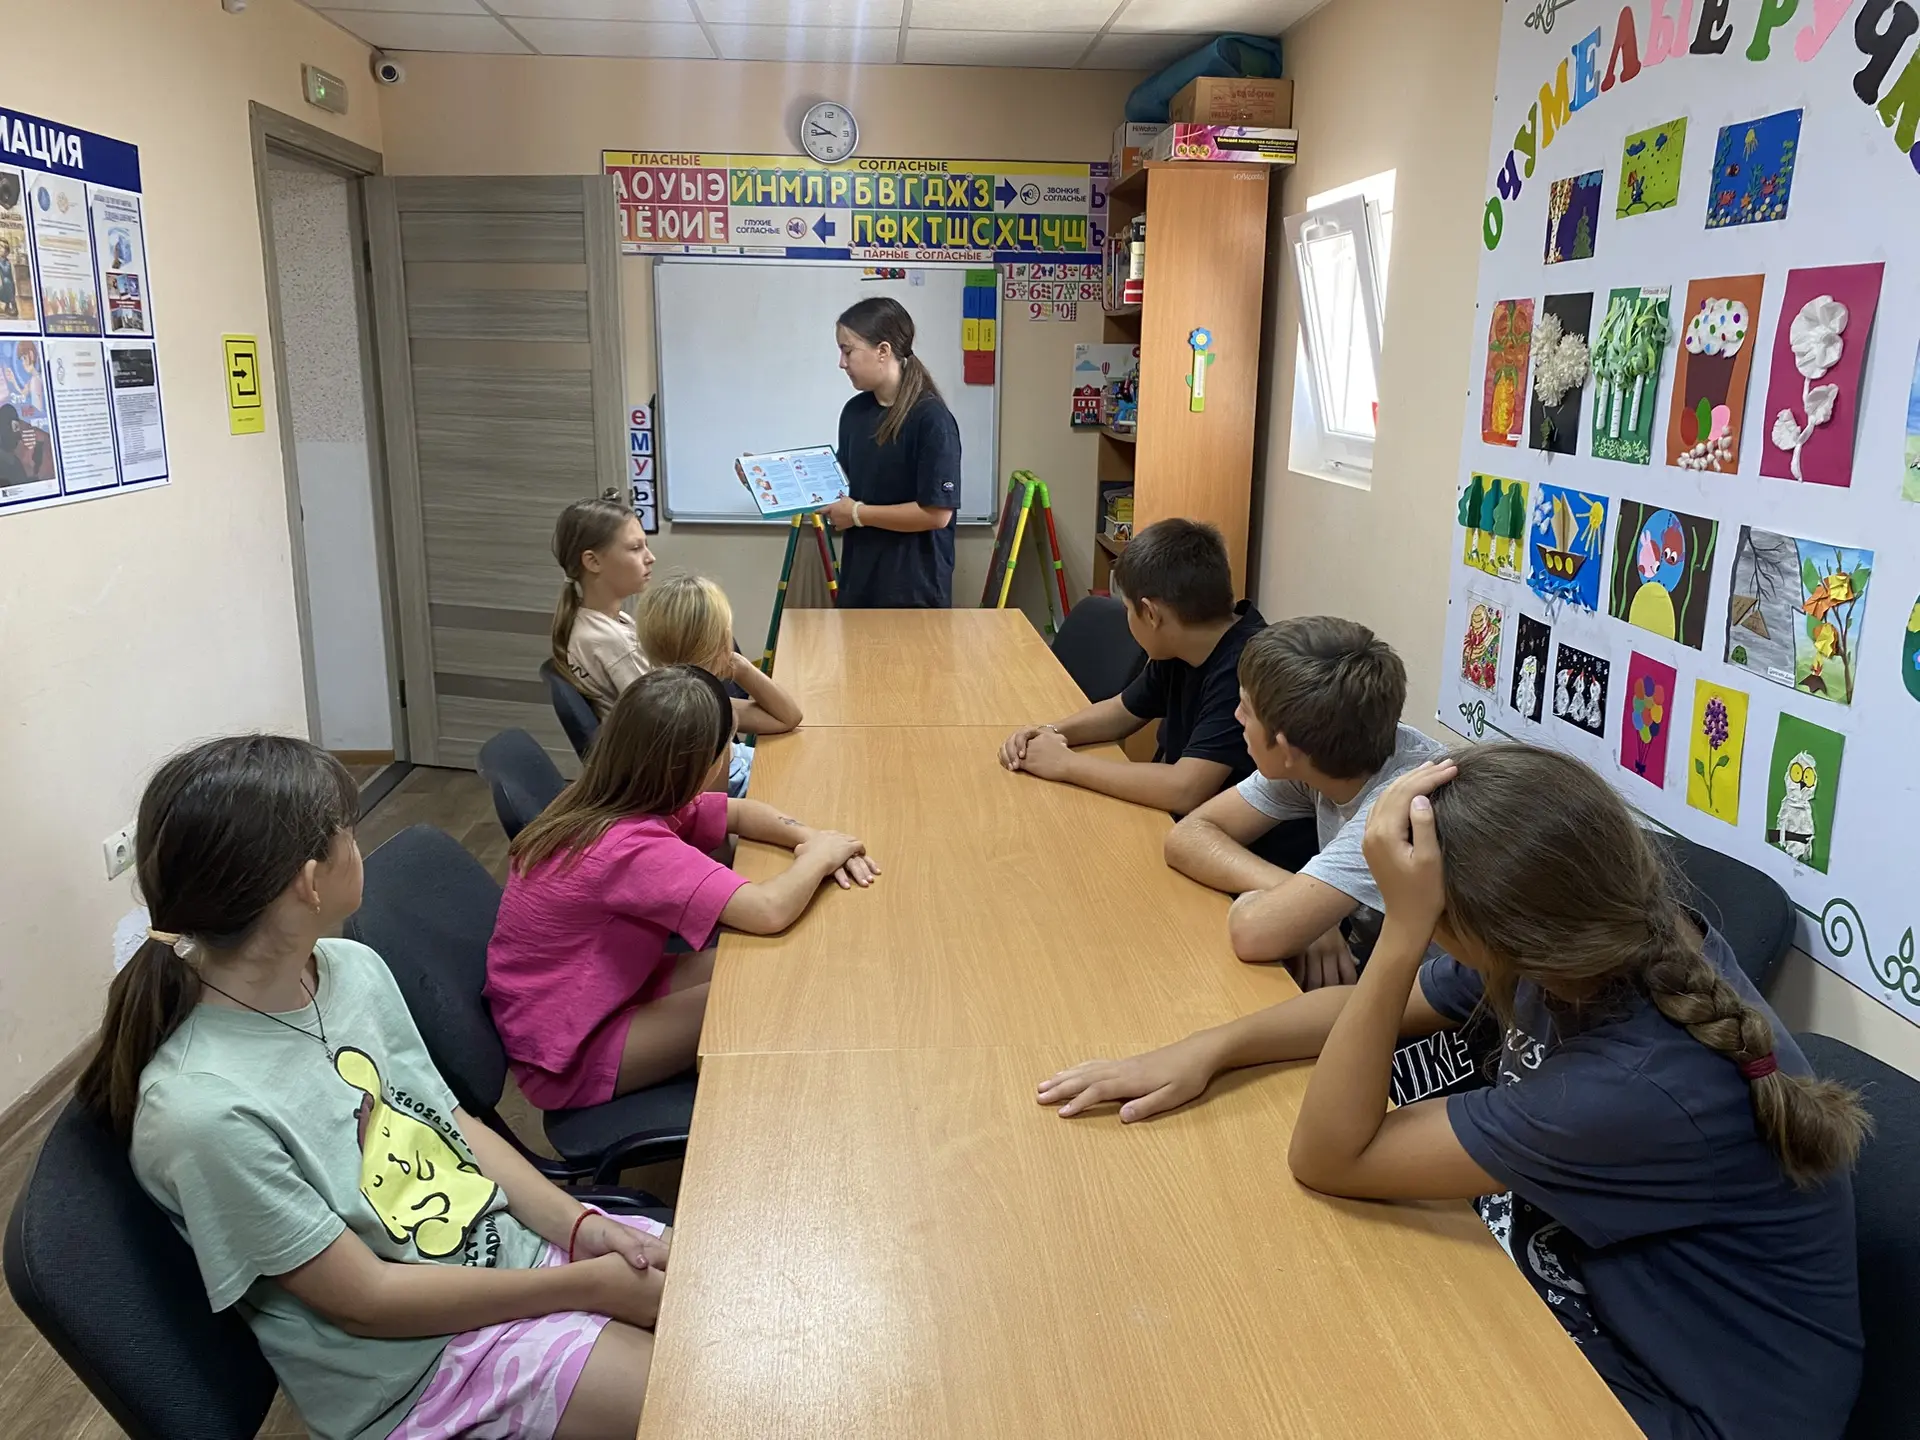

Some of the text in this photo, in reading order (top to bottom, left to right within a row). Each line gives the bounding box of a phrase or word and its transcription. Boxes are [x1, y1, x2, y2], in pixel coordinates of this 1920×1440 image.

[825, 111, 834, 119] 12
[842, 130, 850, 138] 3
[826, 146, 834, 154] 6
[631, 153, 701, 166] ГЛАСНЫЕ
[858, 159, 949, 172] СОГЛАСНЫЕ
[1046, 187, 1081, 195] ЗВОНКИЕ
[1043, 194, 1087, 203] СОГЛАСНЫЕ
[744, 219, 772, 227] ГЛУХИЕ
[735, 226, 781, 235] СОГЛАСНЫЕ
[863, 250, 982, 261] ПАРНЫЕ СОГЛАСНЫЕ
[1006, 263, 1093, 280] 1 2 3 4
[1005, 282, 1092, 300] 5 6 7 8
[1029, 302, 1070, 320] 9 10
[1387, 1030, 1475, 1109] NIKE
[385, 1079, 474, 1156] MPOMPURI
